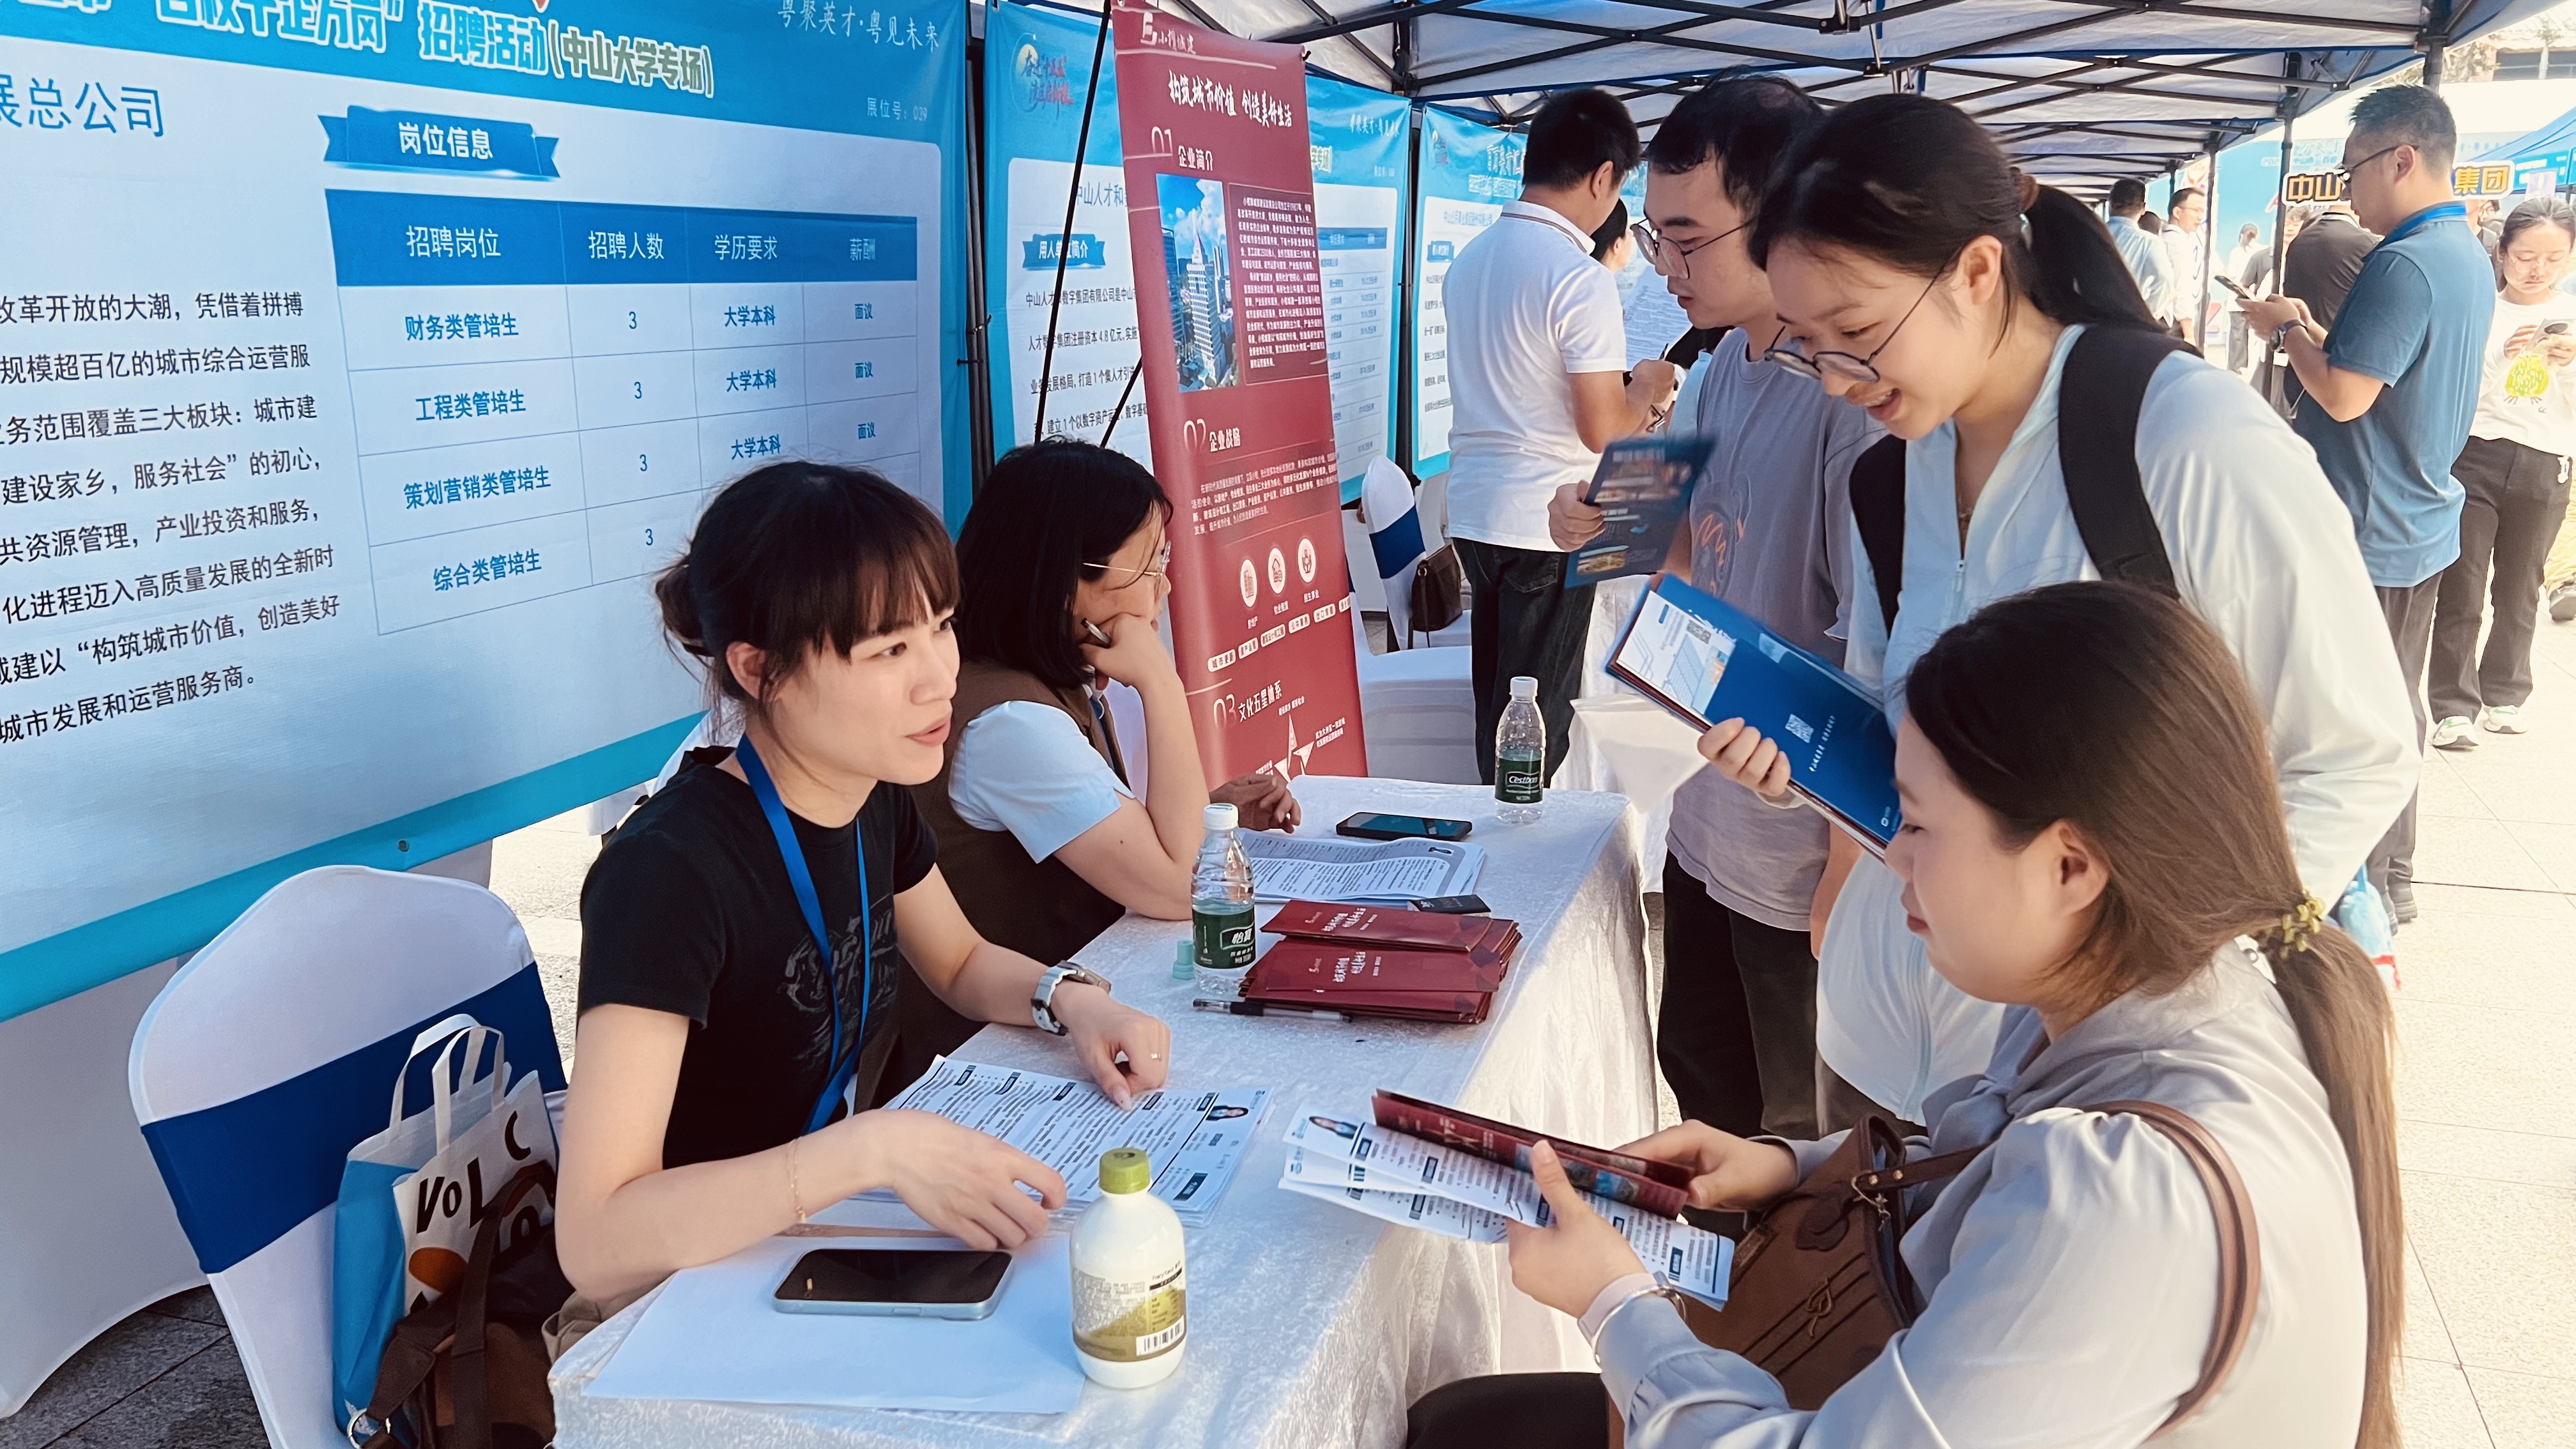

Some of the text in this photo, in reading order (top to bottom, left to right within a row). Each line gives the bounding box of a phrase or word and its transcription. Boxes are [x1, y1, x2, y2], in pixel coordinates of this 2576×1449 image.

[0, 75, 164, 137] 展总公司
[1168, 69, 1292, 129] 构筑城市价值 创造美好生活
[399, 122, 493, 160] 岗位信息
[1178, 144, 1214, 171] 企业简介
[2287, 165, 2509, 201] 中山 集团
[406, 225, 876, 261] 招聘岗位 招聘人数 学历要求 薪酬
[404, 303, 873, 341] 财务类管培生 3 大学本科 面议
[0, 343, 311, 385] 规模超百亿的城市综合运营服
[415, 360, 873, 422] 工程类管培生 3 大学本科 面议
[0, 394, 318, 445] 务范围覆盖三大板块：城市建
[1209, 425, 1241, 453] 企业战略
[402, 422, 876, 510] 策划营销类管培生 3 大学本科 面议
[433, 528, 654, 593] 综合类管培生 3
[3, 544, 334, 625] 化进程迈入高质量发展的全新时
[0, 665, 256, 744] 城市发展和运营服务商。
[1238, 679, 1282, 723] 文化五星体系
